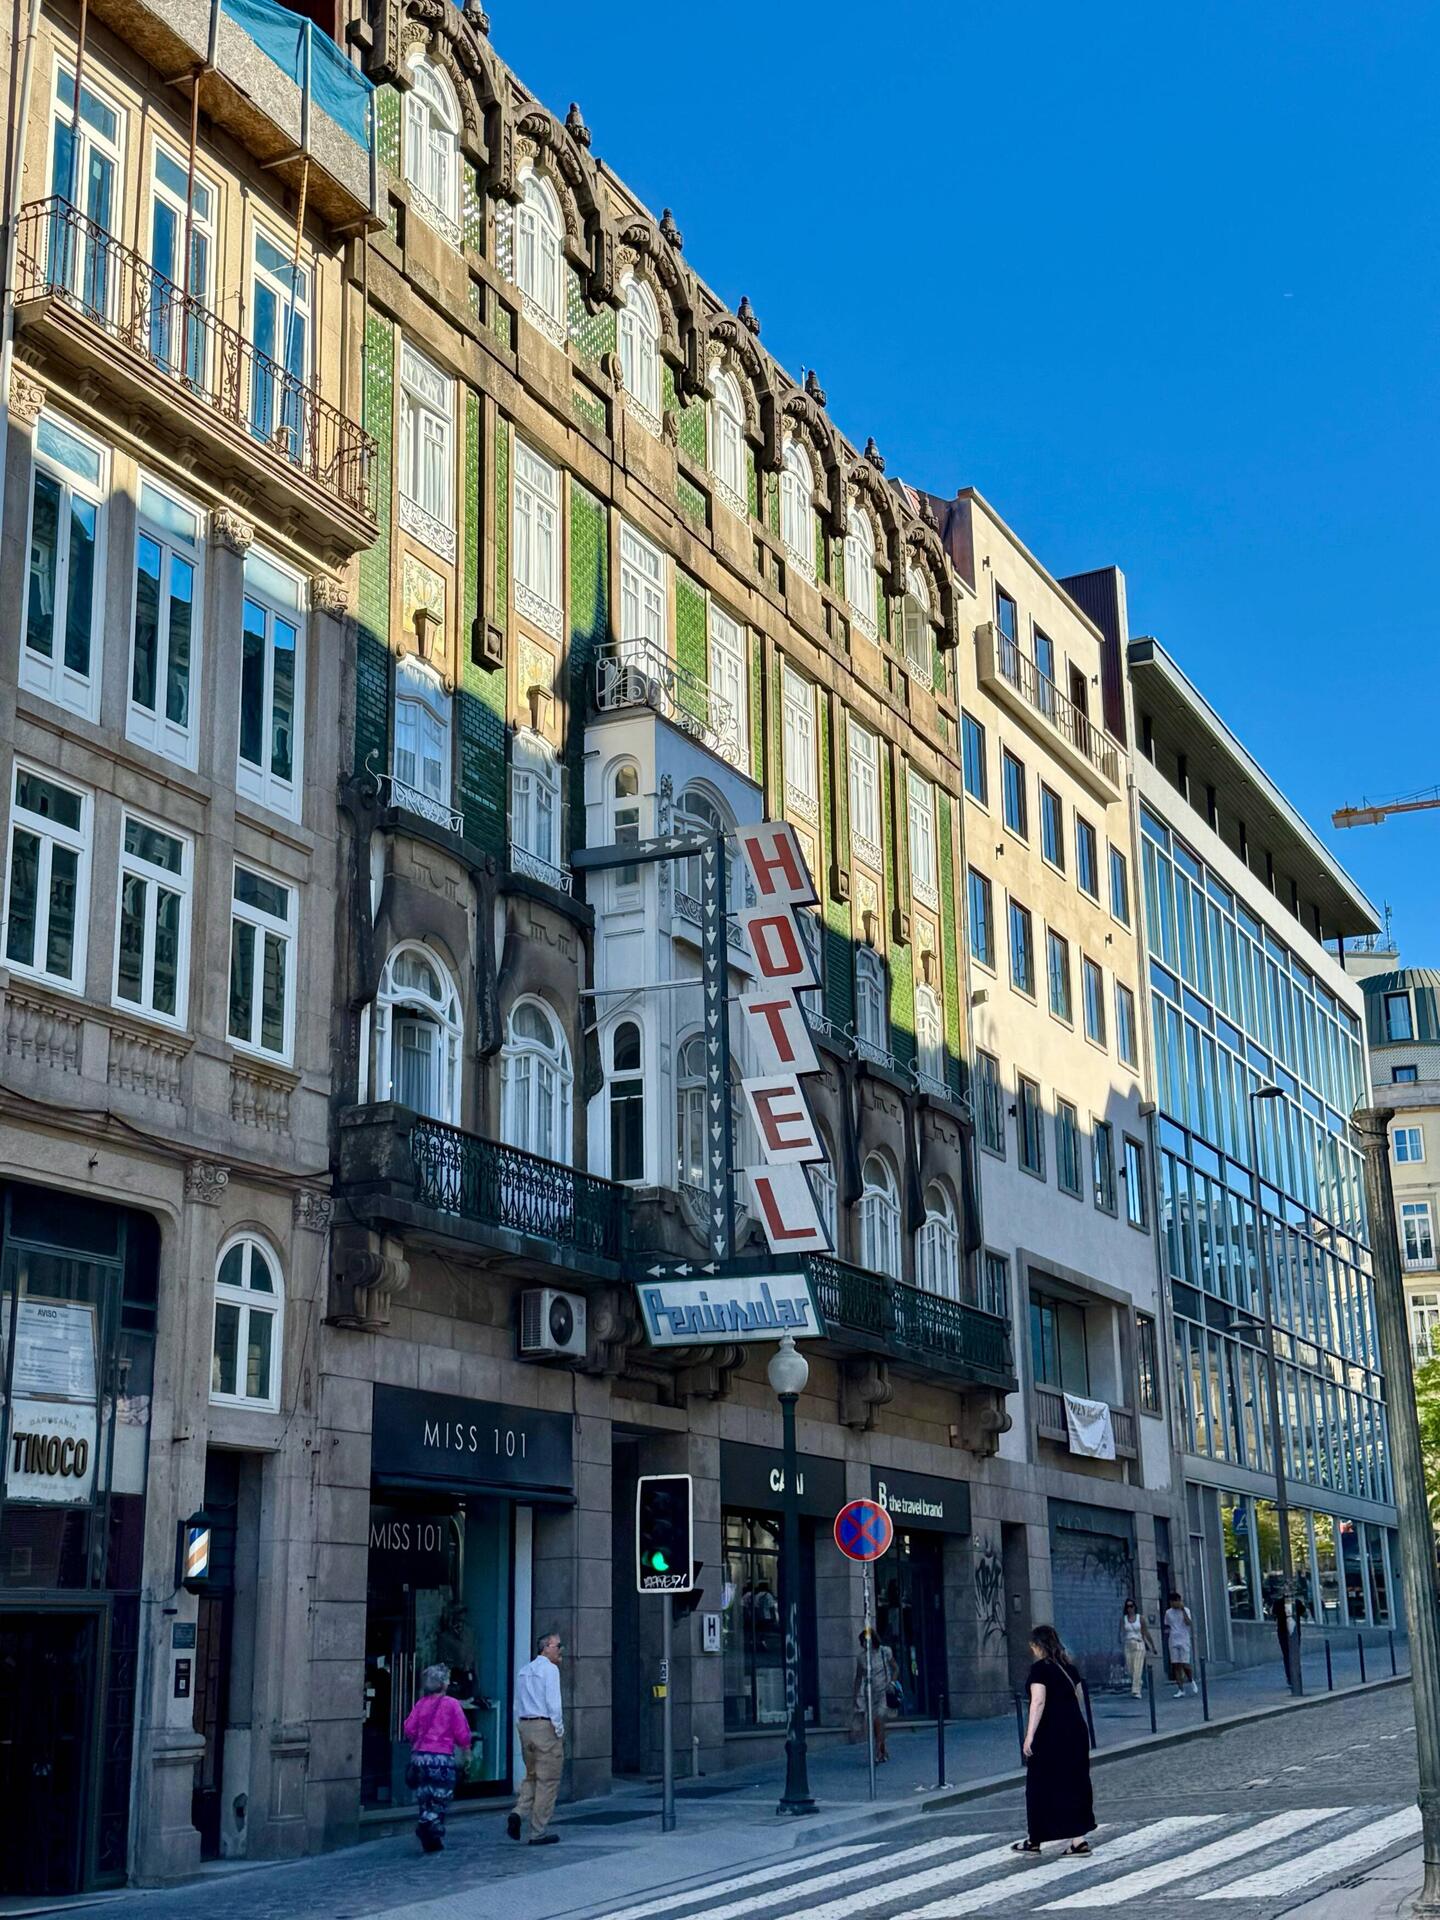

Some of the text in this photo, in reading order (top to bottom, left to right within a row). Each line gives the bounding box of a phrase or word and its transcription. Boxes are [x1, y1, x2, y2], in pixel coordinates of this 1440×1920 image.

[745, 833, 817, 1240] HOTEL
[37, 1308, 58, 1319] AVISO
[643, 1282, 810, 1336] Peninsular
[12, 1431, 89, 1478] TINOCO
[423, 1419, 526, 1459] MISS 101
[878, 1481, 944, 1519] B the travel brand
[369, 1521, 443, 1552] MISS 101
[708, 1616, 716, 1637] H
